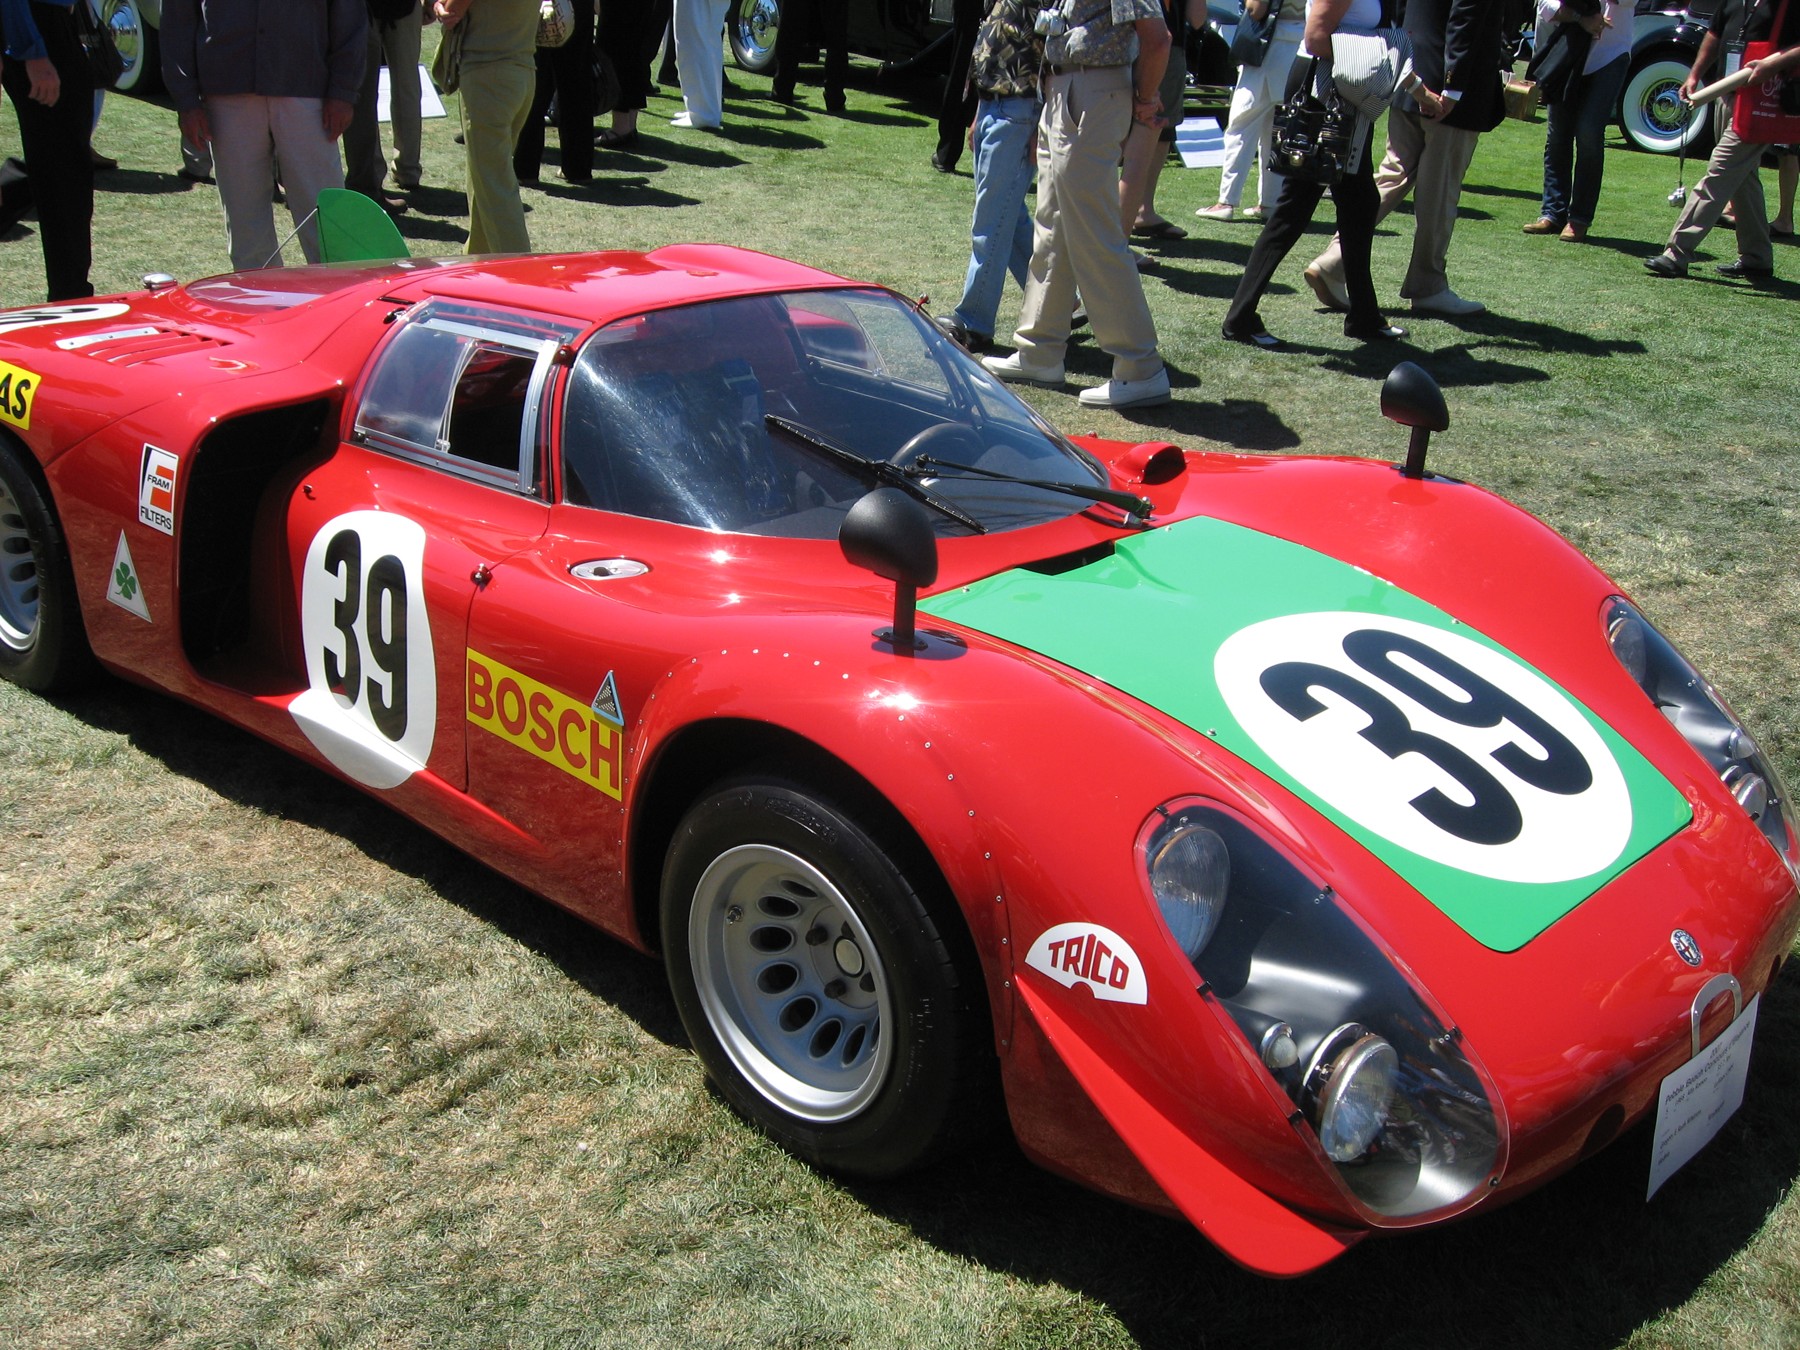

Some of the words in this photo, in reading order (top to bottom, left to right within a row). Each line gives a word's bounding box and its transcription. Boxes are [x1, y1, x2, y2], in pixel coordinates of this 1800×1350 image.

[147, 474, 170, 490] FRAM
[140, 505, 172, 530] FILTERS
[323, 529, 408, 742] 39
[468, 658, 620, 791] BOSCH
[1259, 629, 1593, 846] 39
[1048, 933, 1130, 990] TRICO
[1665, 1085, 1685, 1105] Pebble
[1685, 1069, 1704, 1088] Beach
